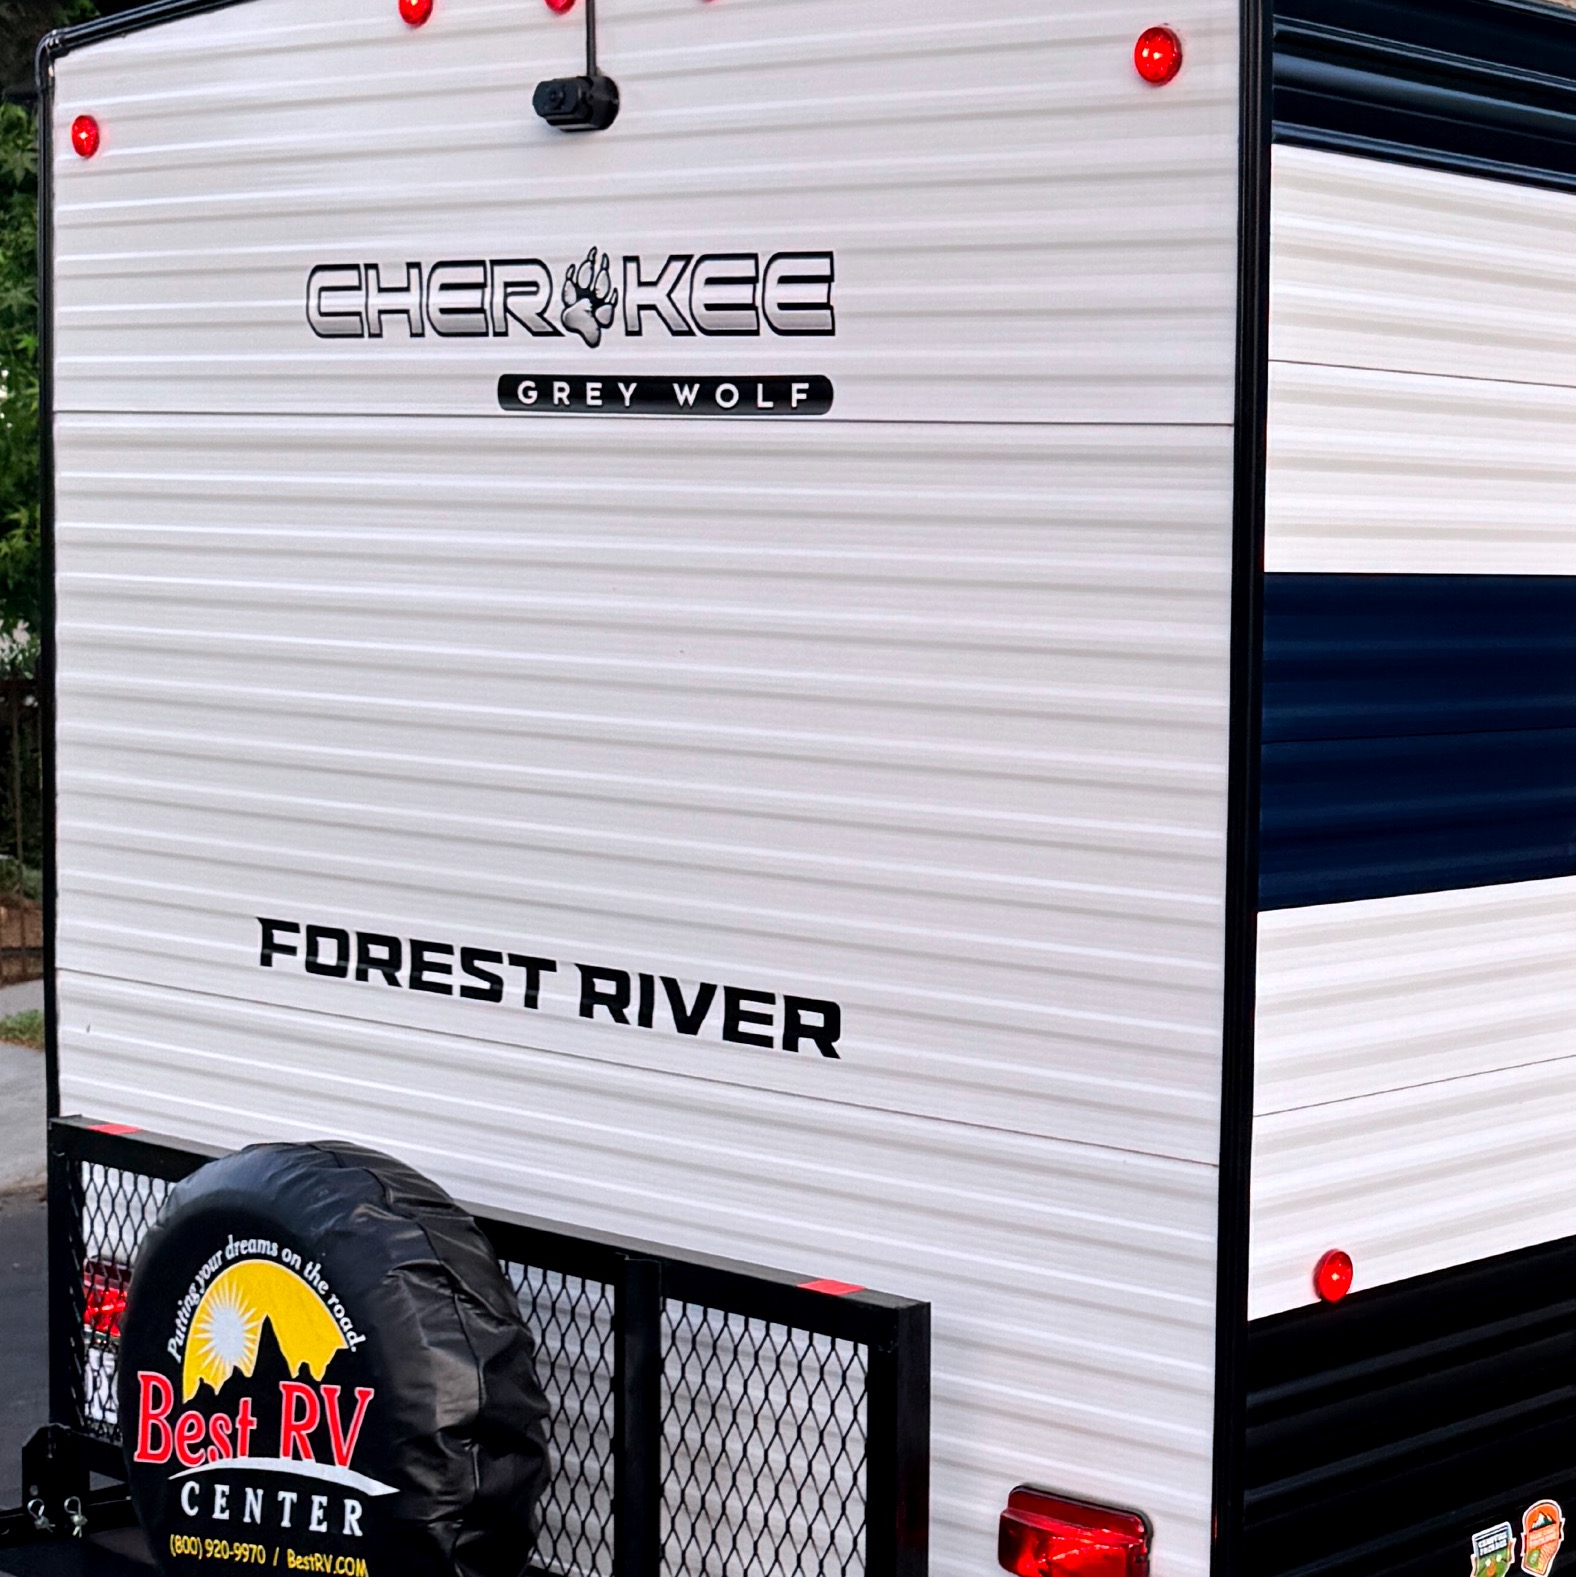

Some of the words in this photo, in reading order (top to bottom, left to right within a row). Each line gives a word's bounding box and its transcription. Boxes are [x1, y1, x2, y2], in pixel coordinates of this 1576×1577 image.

[305, 247, 835, 348] CHEROKEE
[517, 380, 638, 408] GREY
[673, 381, 811, 410] WOLF
[256, 916, 557, 1010] FOREST
[575, 963, 842, 1060] RIVER
[167, 1282, 201, 1364] Putting
[195, 1250, 223, 1294] your
[225, 1234, 279, 1261] dreams
[281, 1247, 303, 1270] on
[303, 1261, 330, 1295] the
[328, 1294, 367, 1353] road.
[133, 1370, 258, 1468] Best
[278, 1380, 375, 1468] RV
[169, 1534, 203, 1560] (800)
[204, 1538, 266, 1565] 920-9970
[180, 1480, 364, 1536] CENTER
